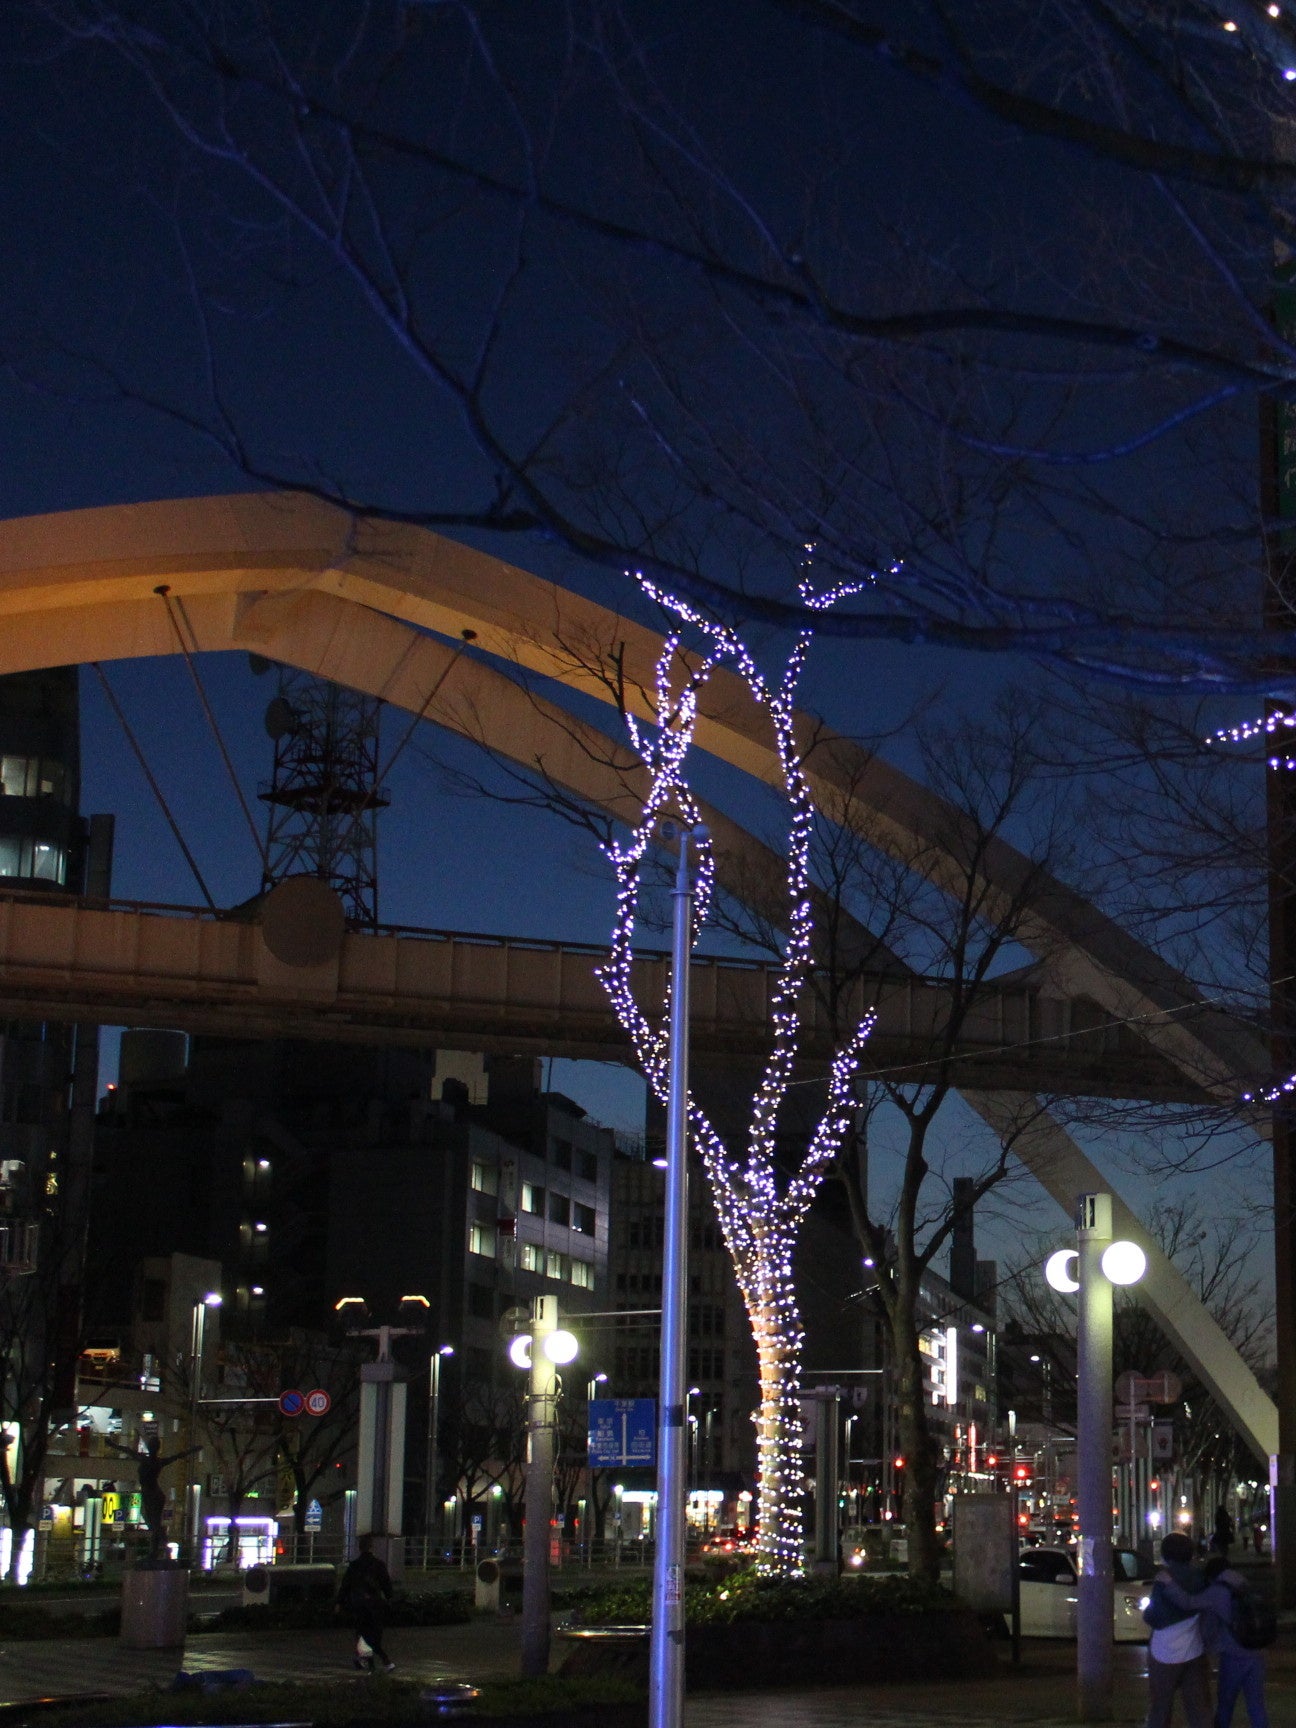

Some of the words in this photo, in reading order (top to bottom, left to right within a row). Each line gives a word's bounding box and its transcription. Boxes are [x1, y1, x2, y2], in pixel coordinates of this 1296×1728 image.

[311, 1396, 325, 1408] 40
[43, 1508, 51, 1519] P
[115, 1510, 123, 1521] P
